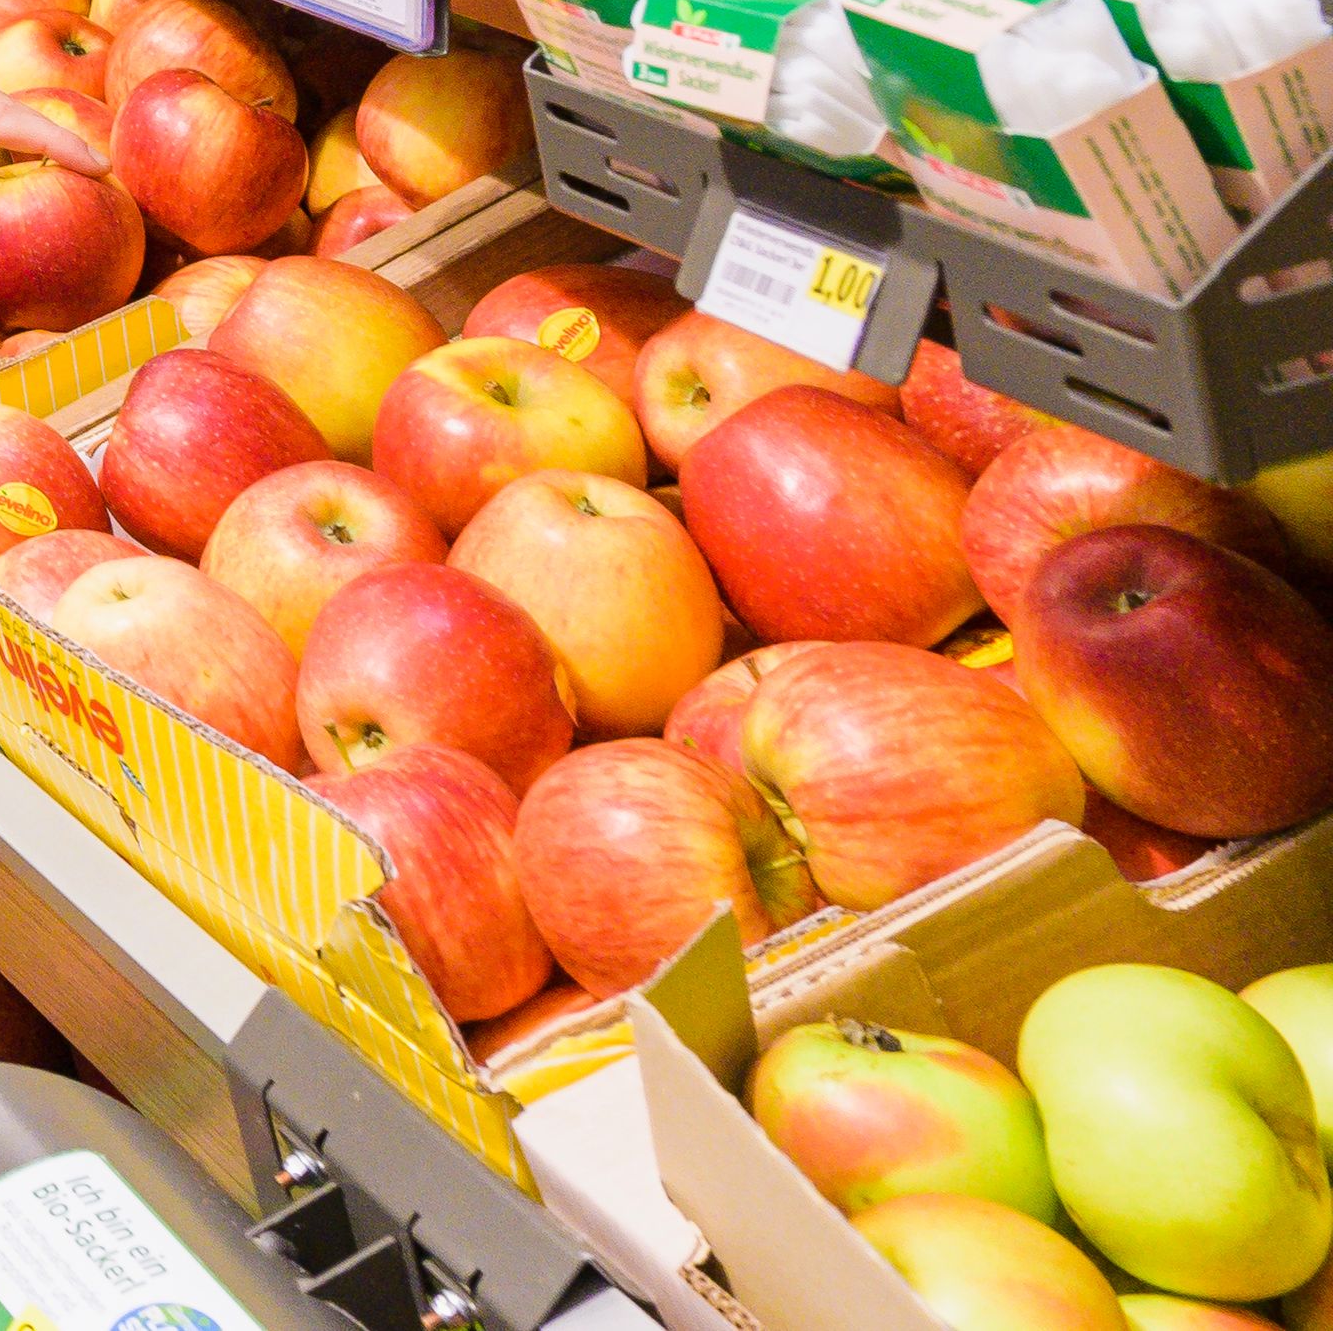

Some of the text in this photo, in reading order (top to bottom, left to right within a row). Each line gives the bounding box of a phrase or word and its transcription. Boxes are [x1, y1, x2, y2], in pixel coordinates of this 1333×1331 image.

[812, 254, 876, 310] 1,00
[553, 313, 590, 351] velina
[32, 1182, 148, 1295] Bio-Sackerl
[65, 1174, 168, 1279] Ich bin ein
